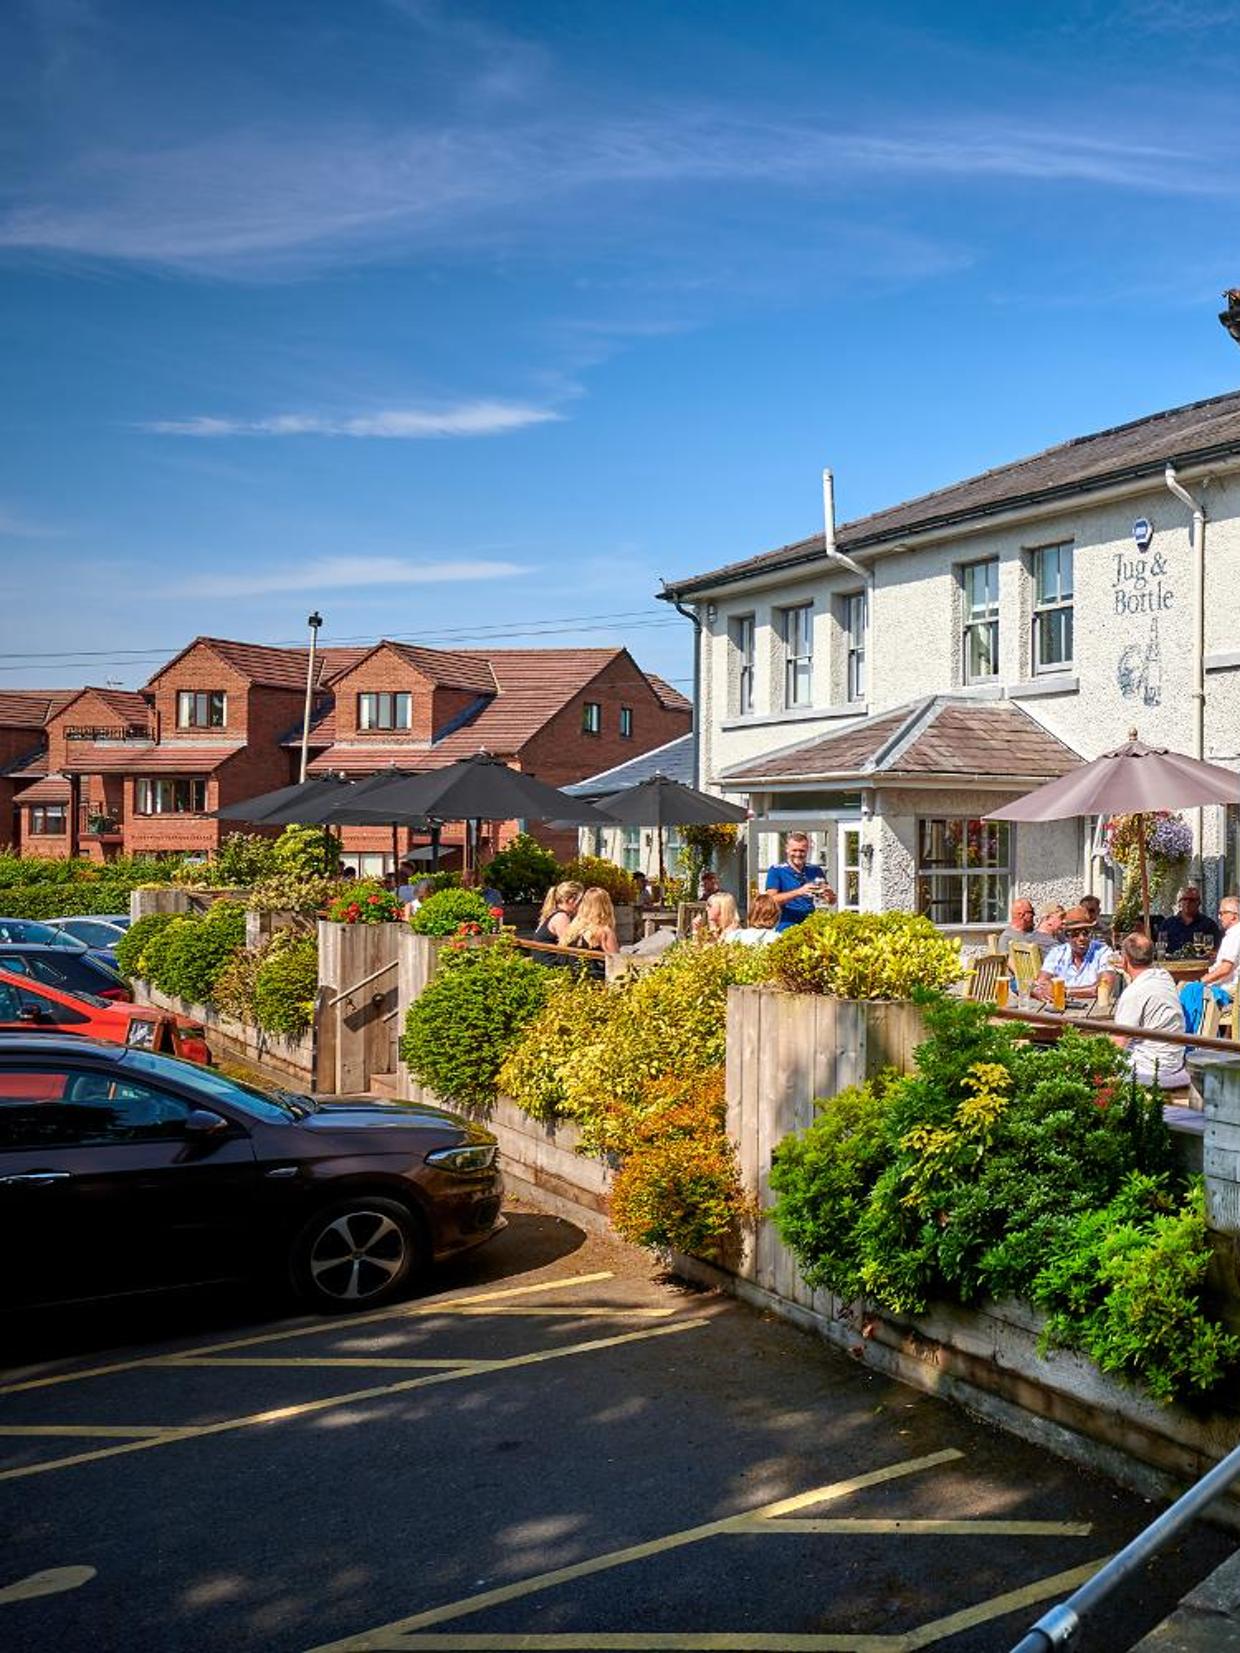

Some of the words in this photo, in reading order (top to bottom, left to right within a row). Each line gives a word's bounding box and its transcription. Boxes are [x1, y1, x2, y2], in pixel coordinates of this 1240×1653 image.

[1112, 553, 1148, 590] Jug
[1150, 551, 1168, 576] &
[1114, 581, 1174, 616] Bottle
